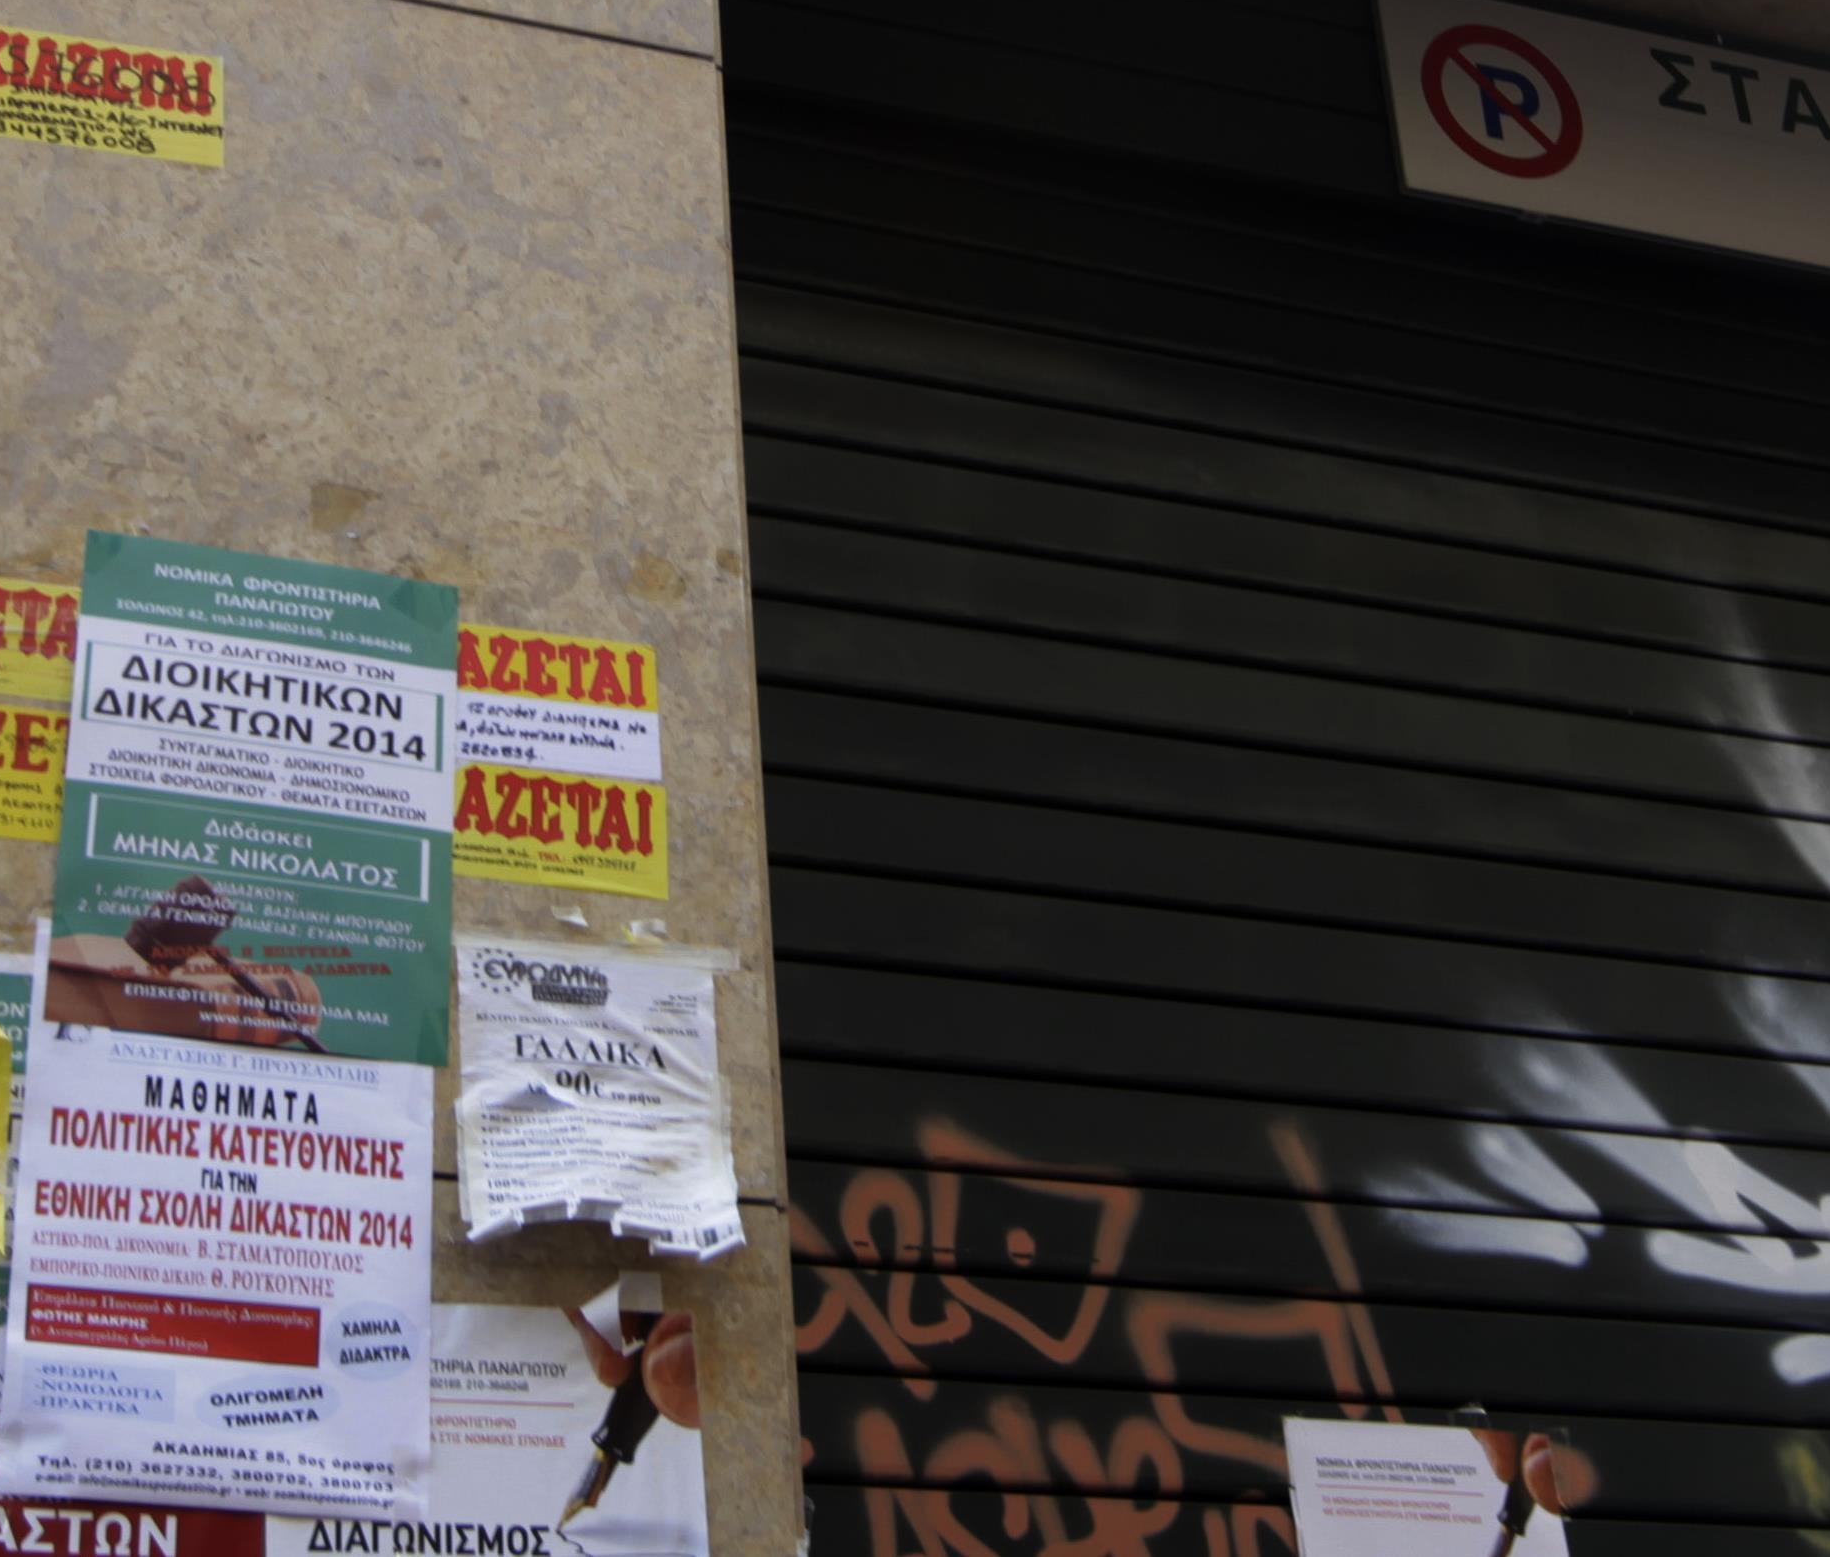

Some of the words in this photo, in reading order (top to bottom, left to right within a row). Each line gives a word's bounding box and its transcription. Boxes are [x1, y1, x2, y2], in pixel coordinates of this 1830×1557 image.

[154, 563, 234, 589] ΝΟΜΙΚΑ
[243, 576, 382, 611] ΦΡΟΝΤΙΣΤΗΡΙΑ
[146, 631, 177, 648] ΓΙΑ
[186, 637, 214, 655] ΤΟ
[221, 642, 346, 675] ΔΙΑΓΩΝΙΣΜΟ
[355, 663, 395, 683] ΤΩΝ
[122, 655, 402, 721] ΔΙΟΙΚΗΤΙΚΩΝ
[94, 688, 312, 745] ΔΙΚΑΣΤΩΝ
[328, 721, 426, 762] 2014
[108, 748, 192, 772] ΔΙΟΙΚΗΤΙΚΗ
[196, 762, 276, 783] ΔΙΚΟΝΟΜΙΑ
[290, 774, 411, 803] ΔΗΜΟΣΙΟΝΟΜΙΚΟ
[159, 738, 270, 765] ΣΥΝΤΑΓΜΑΤΙΚΟ
[284, 757, 365, 780] ΔΙΟΙΚΗΤΙΚΟ
[89, 762, 156, 784] ΣΤΟΙΧΕΙΑ
[160, 773, 267, 799] ΦΟΡΟΛΟΓΙΚΟΥ
[281, 788, 341, 810] ΘΕΜΑΤΑ
[345, 798, 427, 822] ΕΞΕΤΑΣΕΩΝ
[204, 819, 312, 849] Διδάσκει
[113, 831, 221, 865] ΜΗΝΑΣ
[230, 847, 398, 889] ΝΙΚΟΛΑΤΟΣ
[110, 1042, 225, 1070] ΑΝΑΣΤΑΣΙΟΣ
[515, 1033, 667, 1071] ΓΑΛΛΙΚΑ
[145, 1074, 318, 1124] ΜΑΘΗΜΑΤΑ
[50, 1107, 200, 1159] ΠΟΛΙΤΙΚΗΣ
[210, 1123, 405, 1181] ΚΑΤΕΥΘΥΝΣΗΣ
[201, 1168, 224, 1190] ΓΙΑ
[229, 1172, 258, 1195] ΤΗΝ
[35, 1180, 130, 1223] ΕΘΝΙΚΗ
[139, 1190, 222, 1231] ΣΧΟΛΗ
[229, 1200, 352, 1243] ΔΙΚΑΣΤΩΝ
[359, 1211, 413, 1249] 2014
[217, 1241, 364, 1274] ΣΤΑΜΑΤΟΠΟΥΛΟΣ
[232, 1271, 335, 1299] ΡΟΥΚΟΥΝΗΣ
[341, 1319, 401, 1338] ΧΑΜΗΛΑ
[340, 1345, 411, 1366] ΔΙΔΑΚΤΡΑ
[478, 1359, 567, 1379] ΠΑΝΑΓΙΩΤΟΥ
[210, 1385, 324, 1407] ΟΛΙΓΟΜΕΛΗ
[223, 1408, 319, 1428] ΤΜΗΜΑΤΑ
[153, 1441, 258, 1461] ΑΚΑΔΗΜΙΑΣ
[309, 1519, 552, 1557] ΔΙΑΓΩΝΙΣΜΟΣ
